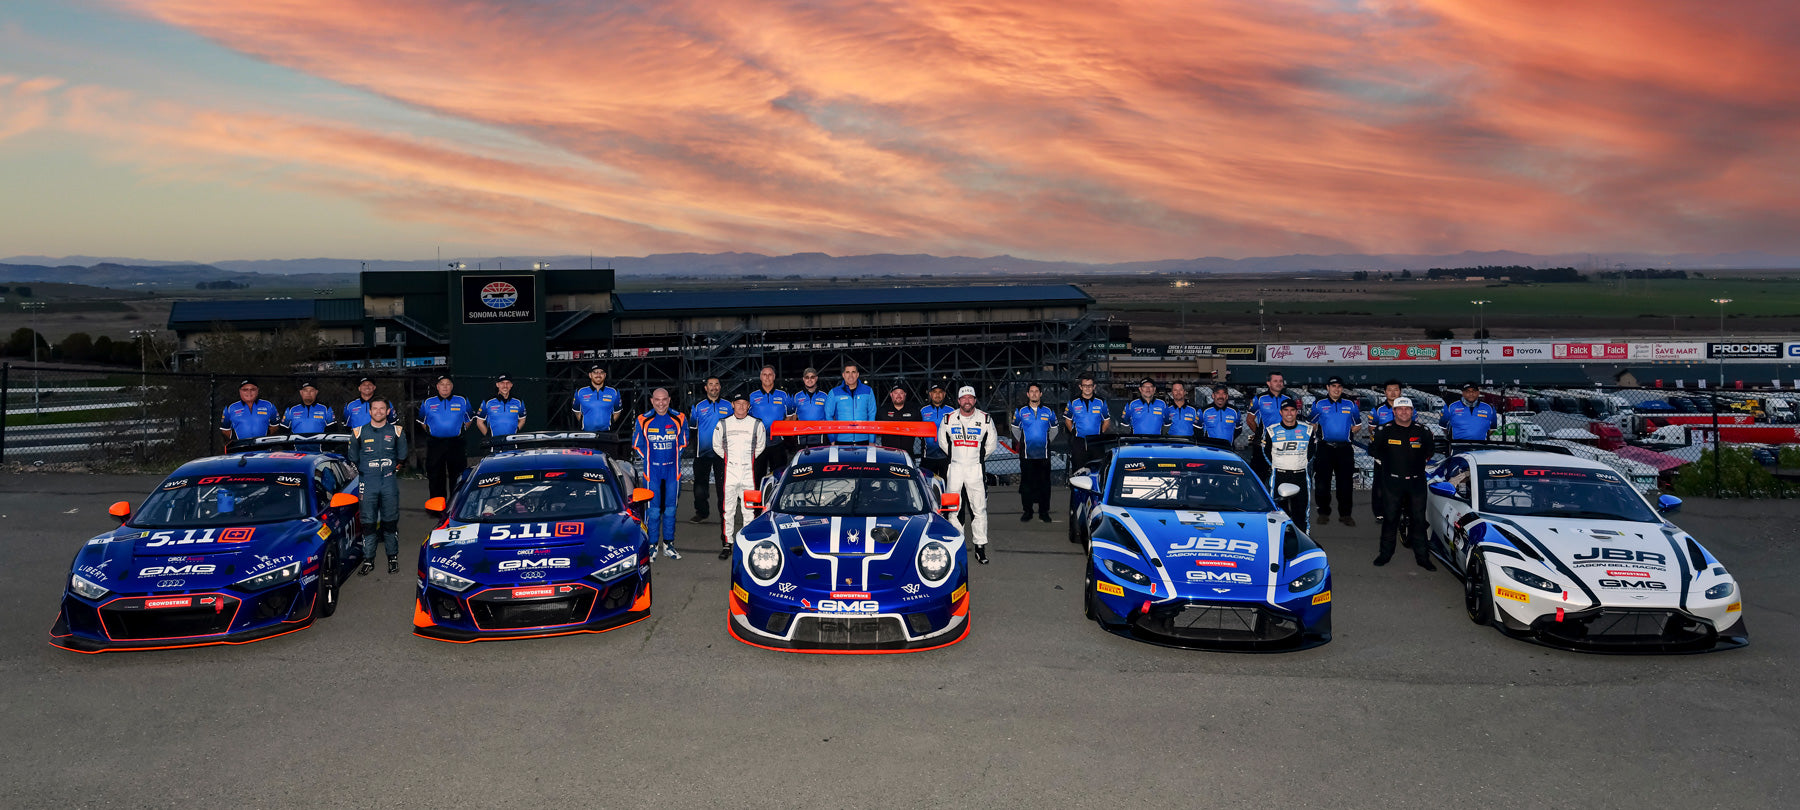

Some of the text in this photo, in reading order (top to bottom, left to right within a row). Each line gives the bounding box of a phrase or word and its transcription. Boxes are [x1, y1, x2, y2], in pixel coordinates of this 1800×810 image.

[1268, 347, 1294, 359] Vegas
[1304, 347, 1330, 359] Vegas
[1339, 347, 1364, 359] Vegas
[1371, 346, 1400, 357] O'Reilly
[1407, 346, 1437, 357] O'Reilly
[1607, 346, 1625, 354] Falck
[1712, 344, 1778, 353] PROCORE
[506, 433, 598, 441] GMG
[1277, 442, 1308, 451] JBR
[793, 466, 812, 475] aws
[890, 466, 910, 475] aws
[1223, 465, 1243, 473] aws
[198, 476, 231, 484] GT
[277, 476, 300, 484] aws
[478, 476, 500, 485] aws
[1596, 473, 1618, 481] aws
[164, 479, 188, 488] aws
[1193, 513, 1206, 521] 2
[448, 530, 461, 540] 8
[490, 523, 551, 540] 5.11
[146, 528, 216, 547] 5.11
[1170, 537, 1258, 554] JBR
[600, 545, 634, 563] LIBERTY
[1573, 547, 1666, 565] JBR
[246, 555, 294, 575] LIBERTY
[431, 556, 466, 572] LIBERTY
[498, 558, 571, 569] GMG
[78, 565, 108, 582] LIBERTY
[139, 564, 216, 576] GMG
[1186, 570, 1252, 582] GMG
[1099, 583, 1122, 594] PIRELLI
[1598, 579, 1667, 589] GMG
[734, 585, 747, 601] PIRELLI
[1313, 593, 1330, 604] PIRELLI
[1498, 588, 1526, 600] PIRELLI
[818, 600, 879, 611] GMG
